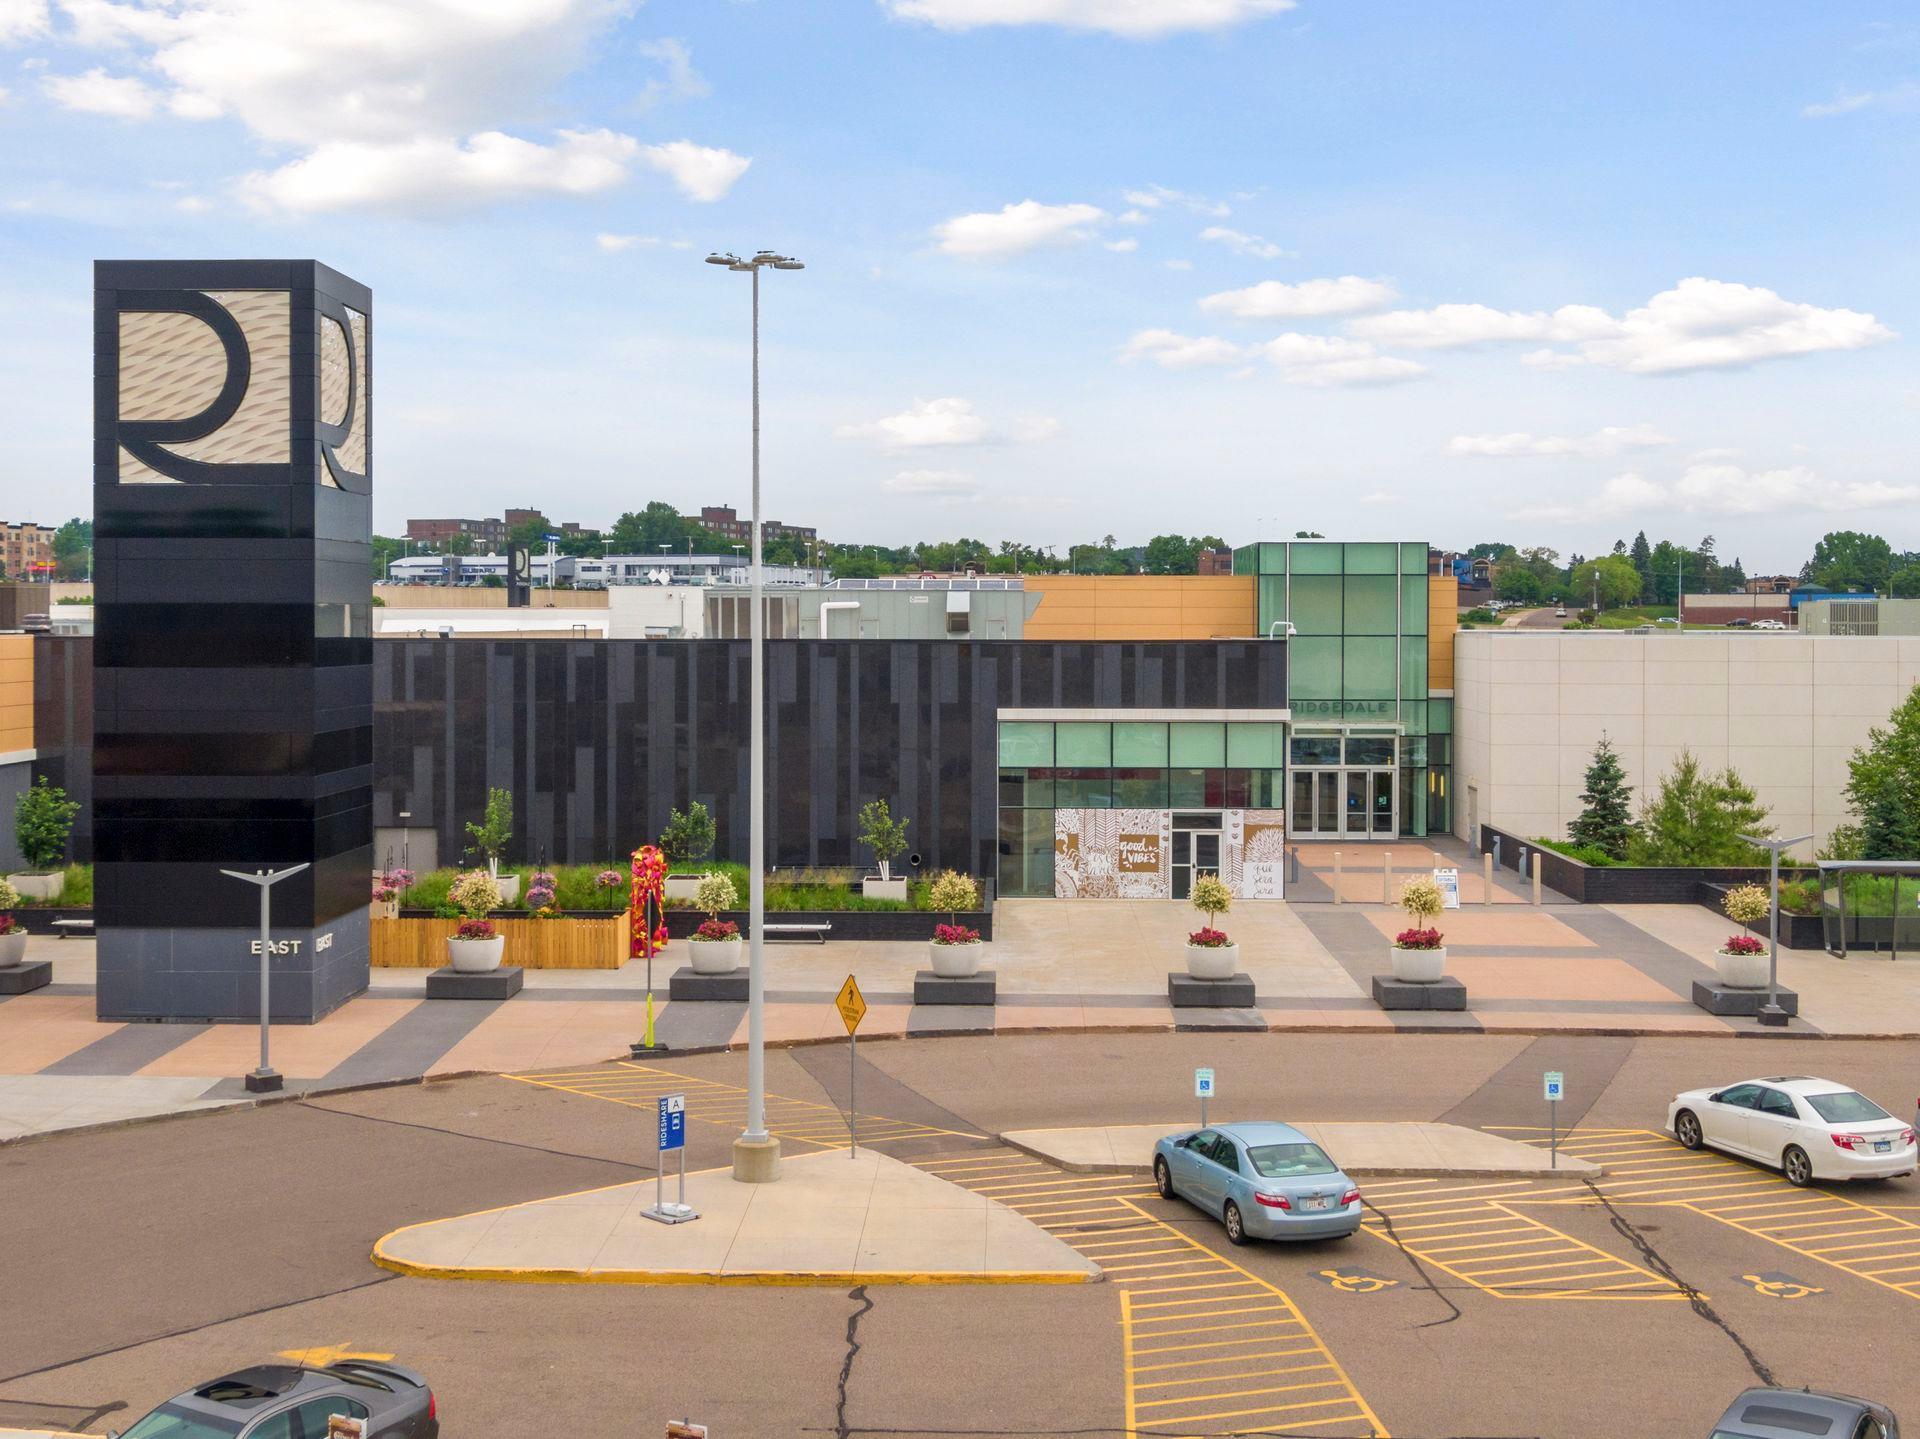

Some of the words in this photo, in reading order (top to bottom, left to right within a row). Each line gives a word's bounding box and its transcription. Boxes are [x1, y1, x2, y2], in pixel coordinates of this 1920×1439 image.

[101, 288, 290, 486] R
[1289, 702, 1388, 713] RIDGEDALE
[1120, 838, 1147, 859] good
[1128, 852, 1156, 863] VIBES
[251, 940, 302, 954] EAST
[672, 1099, 680, 1110] A
[660, 1099, 668, 1147] RIDESHARE
